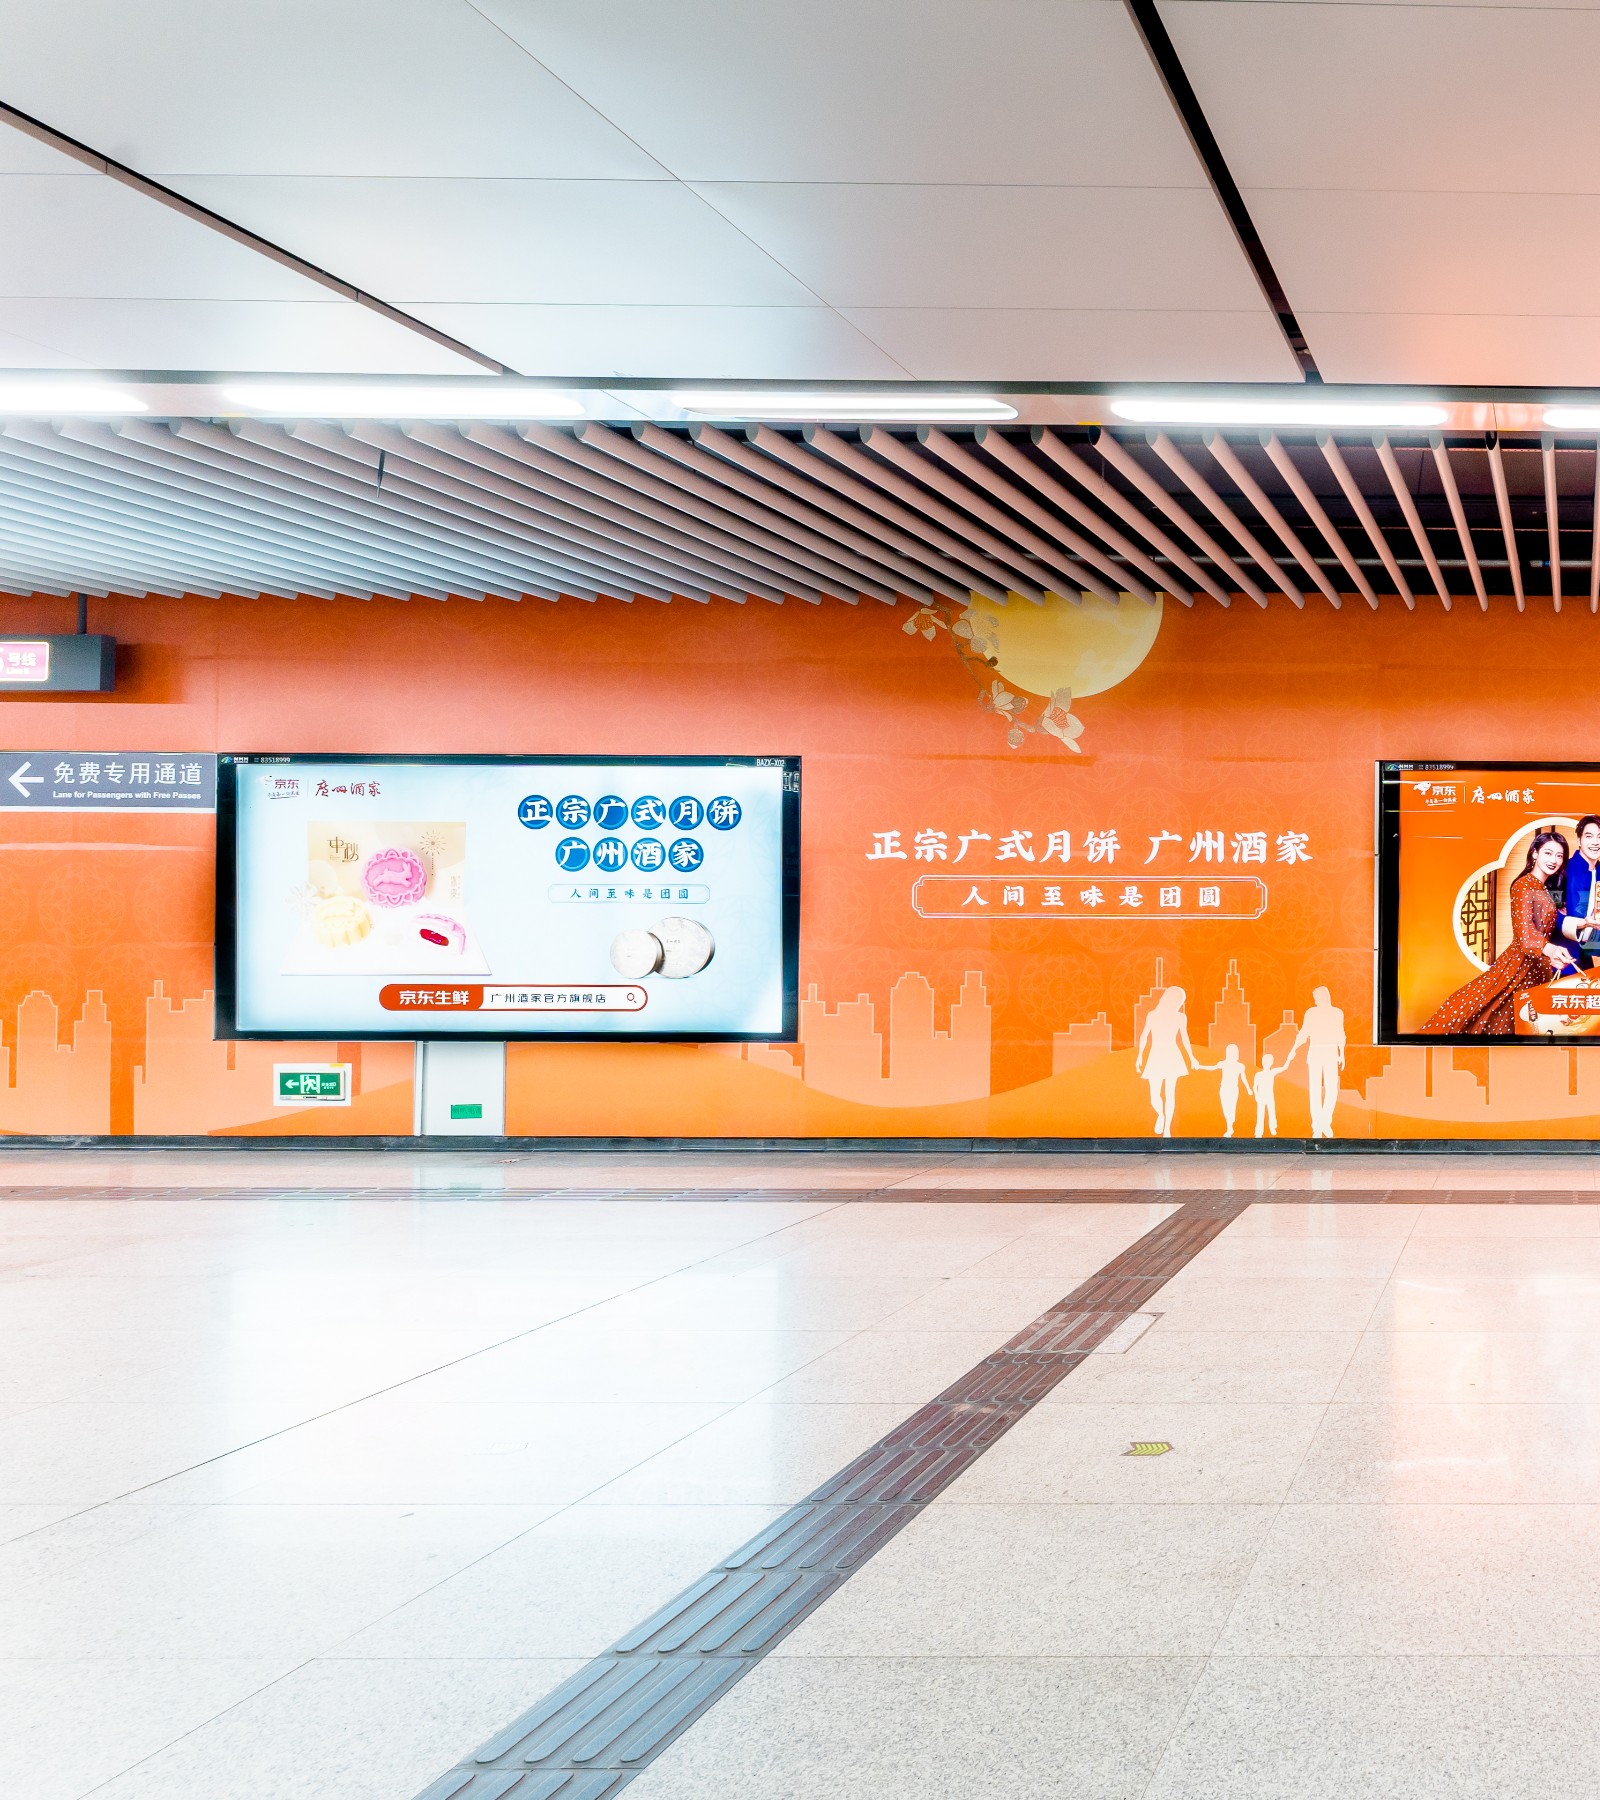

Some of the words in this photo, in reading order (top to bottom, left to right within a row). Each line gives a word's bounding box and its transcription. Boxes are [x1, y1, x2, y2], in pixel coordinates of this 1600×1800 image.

[53, 761, 203, 785] 免费专用通道
[274, 779, 300, 789] 京东
[1432, 785, 1457, 796] 京东
[74, 791, 86, 799] for
[87, 791, 133, 800] Passengers
[173, 792, 201, 800] Passes
[518, 797, 740, 825] 正宗广式月饼
[557, 840, 702, 868] 广州酒家
[865, 827, 1122, 866] 正宗广式月饼
[1142, 829, 1314, 866] 广州酒家
[569, 888, 689, 899] 人间至味是团圆
[960, 884, 1222, 908] 人间至味是团圆
[399, 990, 470, 1006] 京东生鲜
[490, 993, 607, 1004] 广州酒家官方旗舰店
